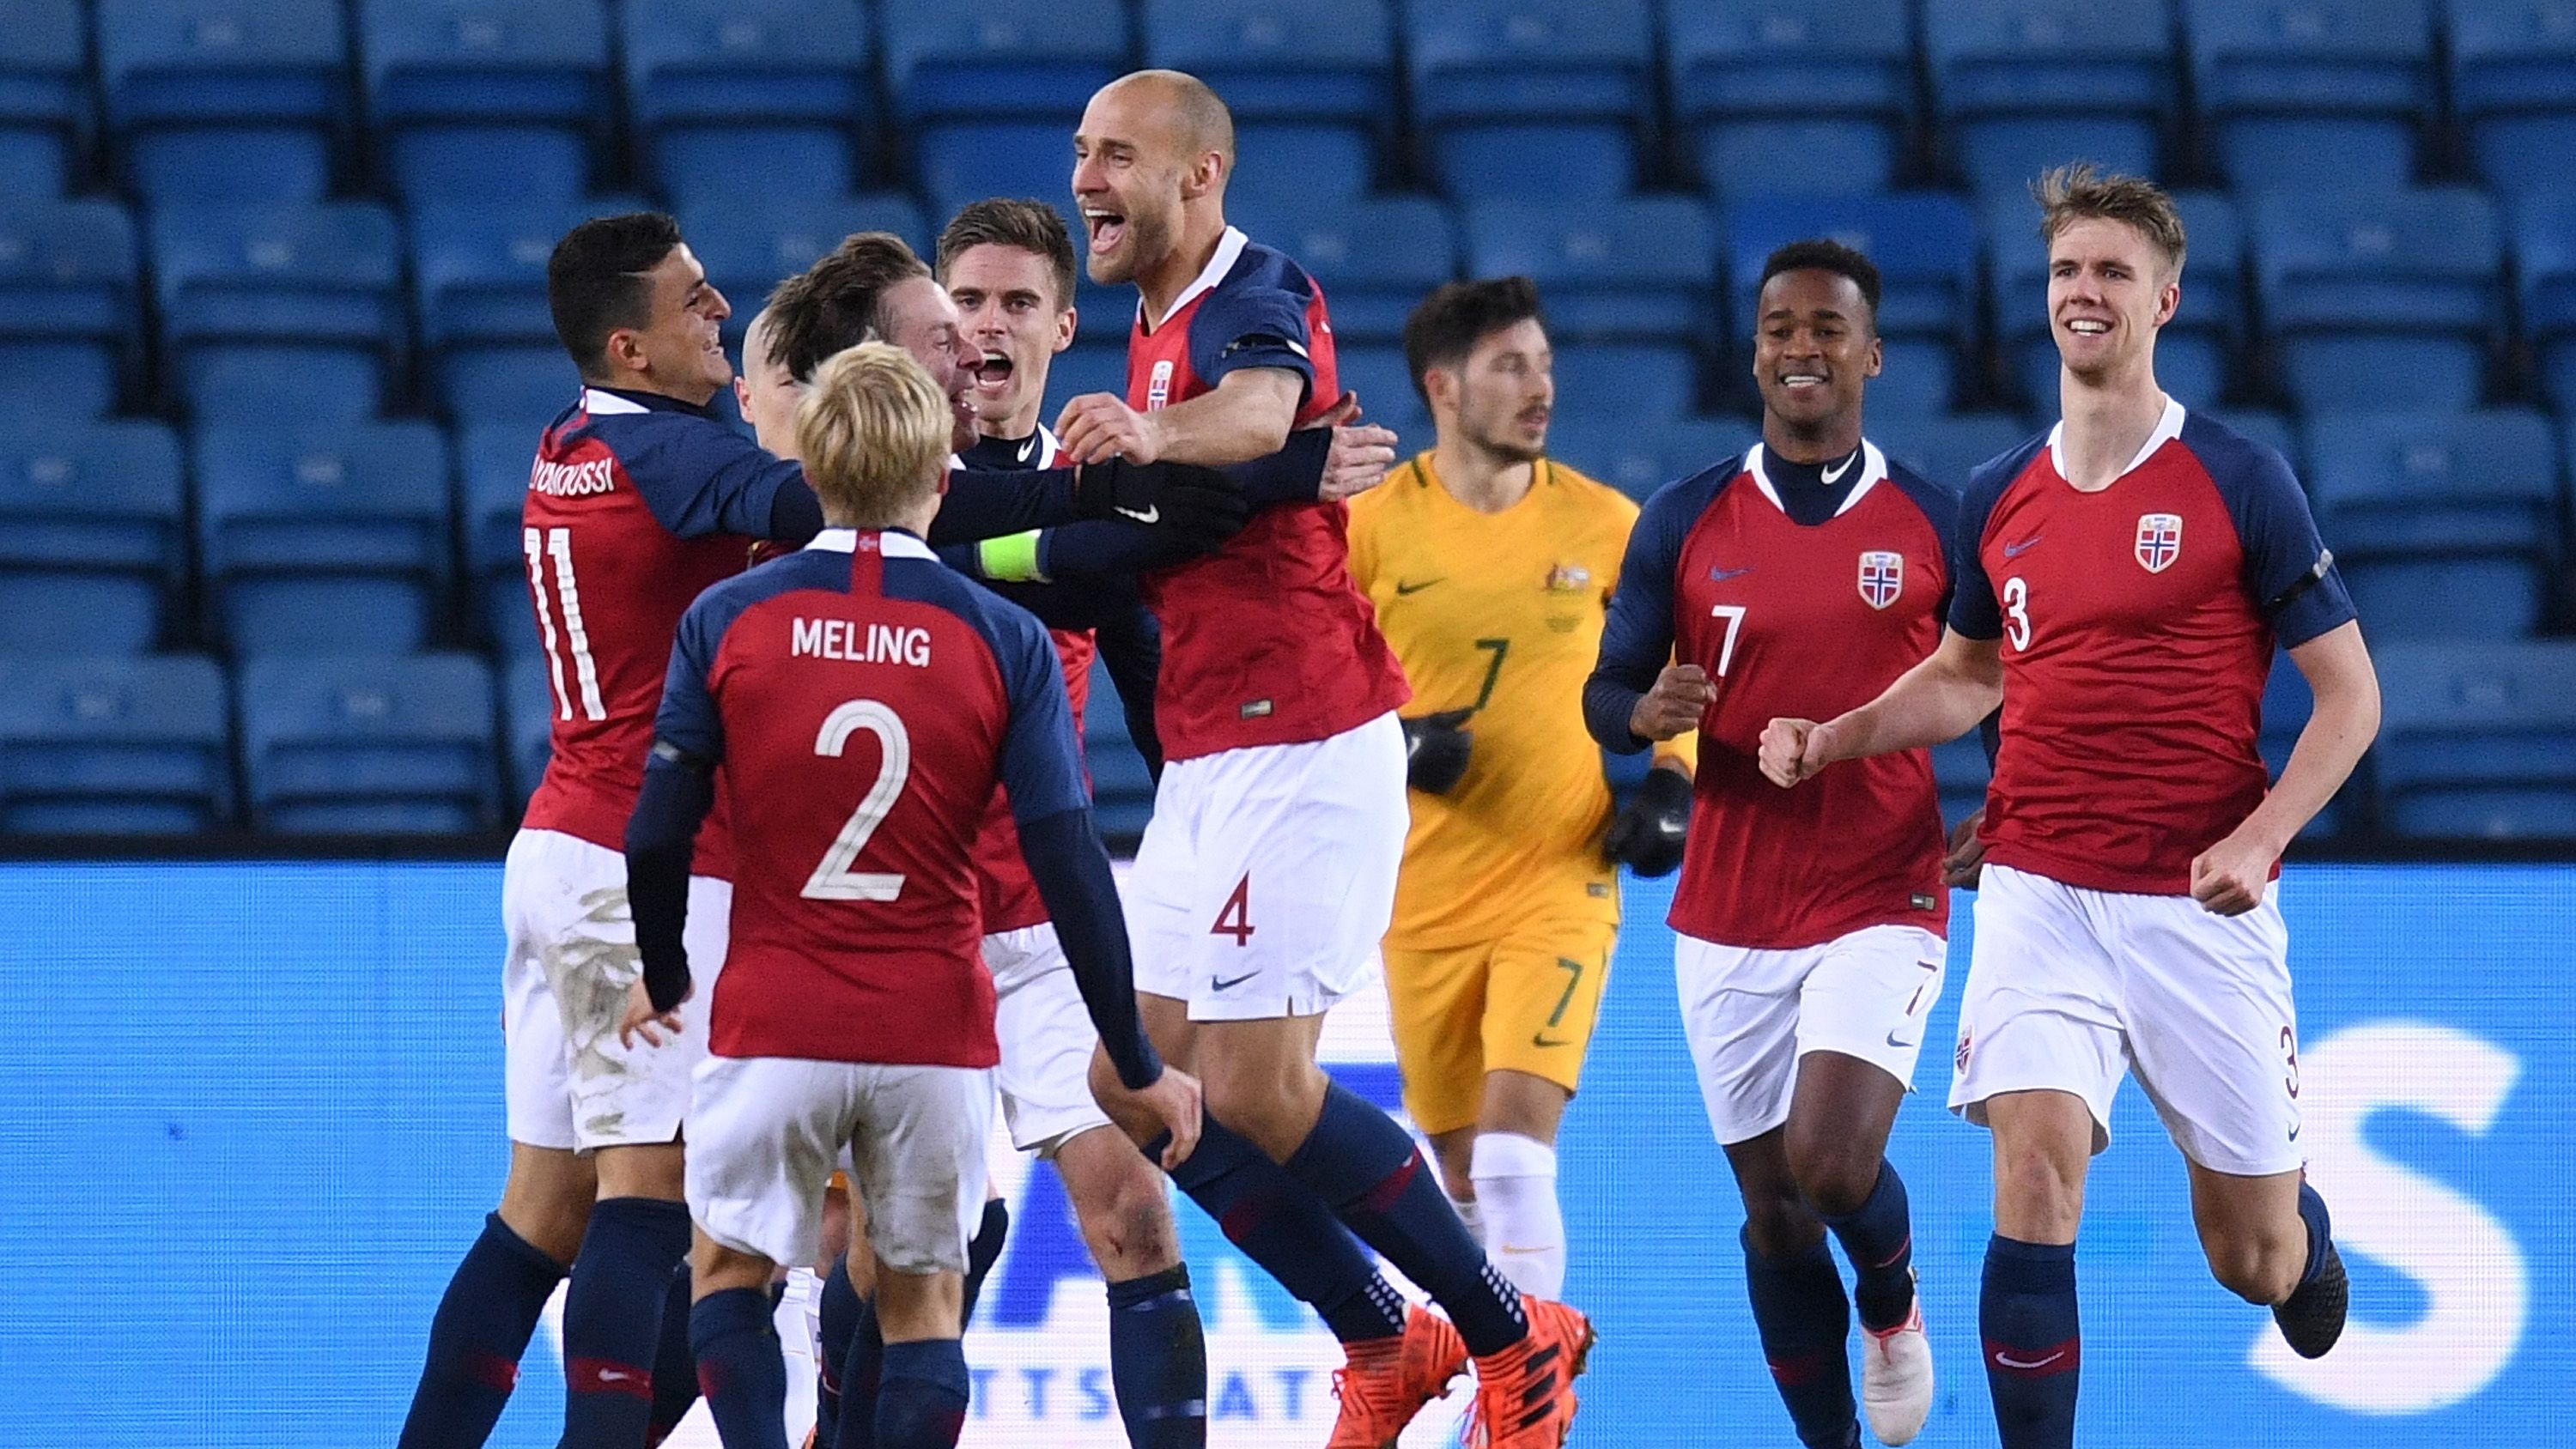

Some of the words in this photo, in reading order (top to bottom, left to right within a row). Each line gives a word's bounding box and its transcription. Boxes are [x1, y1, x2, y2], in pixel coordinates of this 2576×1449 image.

[524, 528, 607, 721] 11
[790, 617, 932, 668] MELING
[1710, 606, 1747, 677] 7
[2002, 578, 2032, 652] 3
[1473, 638, 1509, 712] 7
[799, 698, 910, 902] 2
[1210, 870, 1255, 947] 4
[1547, 956, 1583, 1028] 7
[1905, 960, 1938, 1016] 7
[2280, 1025, 2300, 1100] 3
[2245, 1017, 2530, 1416] S
